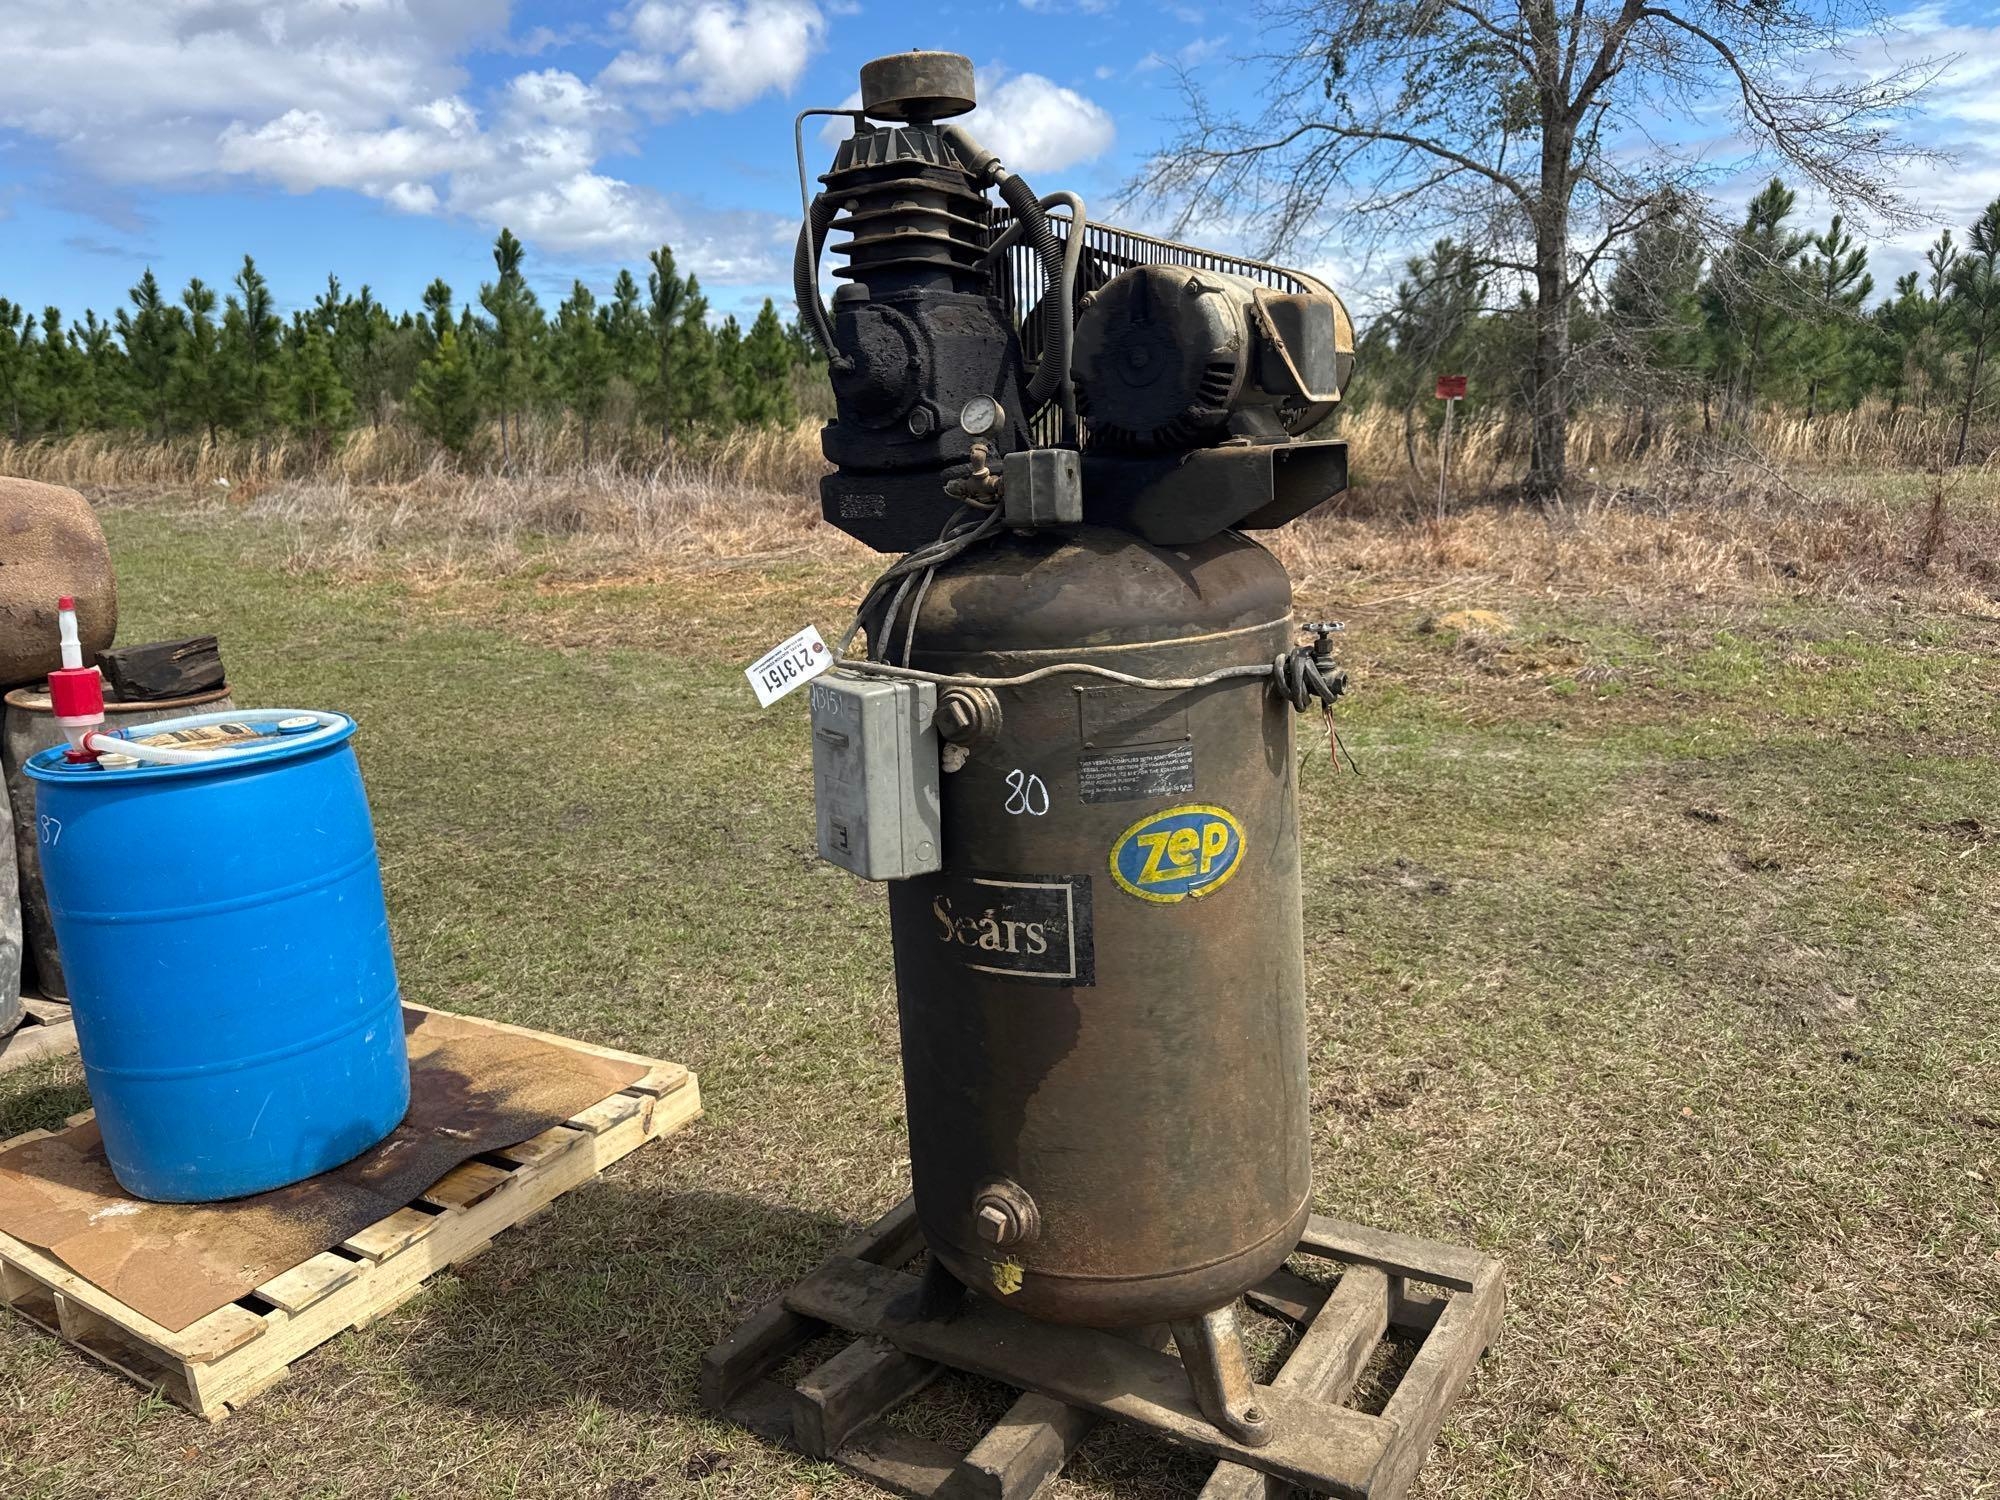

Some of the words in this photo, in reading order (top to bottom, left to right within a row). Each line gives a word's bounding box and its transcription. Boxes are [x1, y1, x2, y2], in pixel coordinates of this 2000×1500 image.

[761, 648, 815, 693] 213151
[1004, 768, 1050, 816] 80
[40, 814, 62, 846] 87
[931, 894, 1048, 955] Sears
